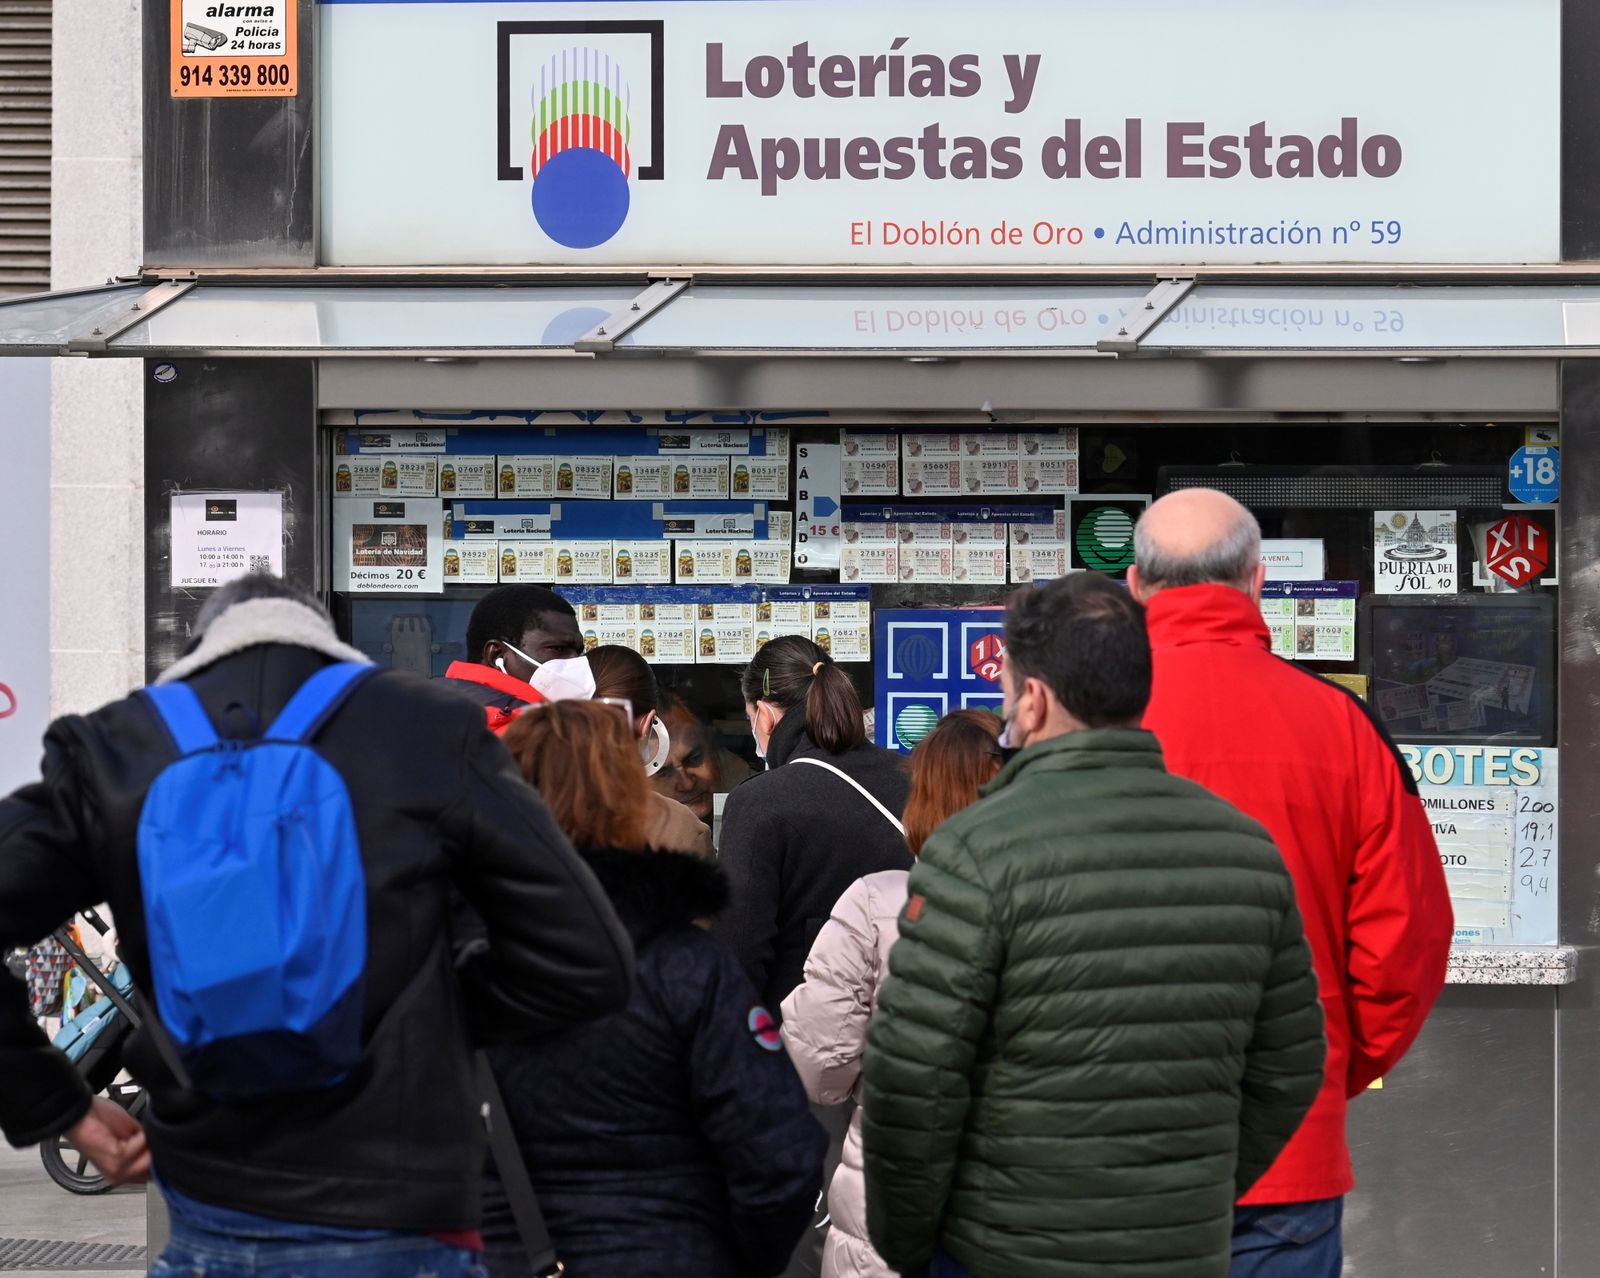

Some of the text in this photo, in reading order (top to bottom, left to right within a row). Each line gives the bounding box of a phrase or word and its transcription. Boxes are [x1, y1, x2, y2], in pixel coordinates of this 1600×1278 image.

[205, 3, 275, 18] alarma
[235, 26, 279, 37] Policía
[230, 40, 281, 50] 24 horas
[180, 64, 290, 87] 914 339 800
[705, 36, 1042, 114] Loterías y
[706, 116, 1403, 197] Apuestas del Estado
[850, 219, 1402, 246] El Doblón de Oro Administración nº 59
[1510, 456, 1556, 485] +18
[809, 525, 840, 536] 15 €
[383, 547, 393, 555] de
[393, 547, 423, 555] Navidad
[350, 569, 426, 580] Décimos 20 €
[1378, 560, 1455, 575] PUERTA DEL
[1394, 574, 1451, 592] SOL 10
[1401, 747, 1540, 786] BOTES
[1421, 798, 1495, 811] OMILLONES
[1519, 795, 1554, 813] 200
[1430, 823, 1457, 835] TIVA
[1440, 854, 1467, 866] OTO
[1455, 929, 1481, 937] ones
